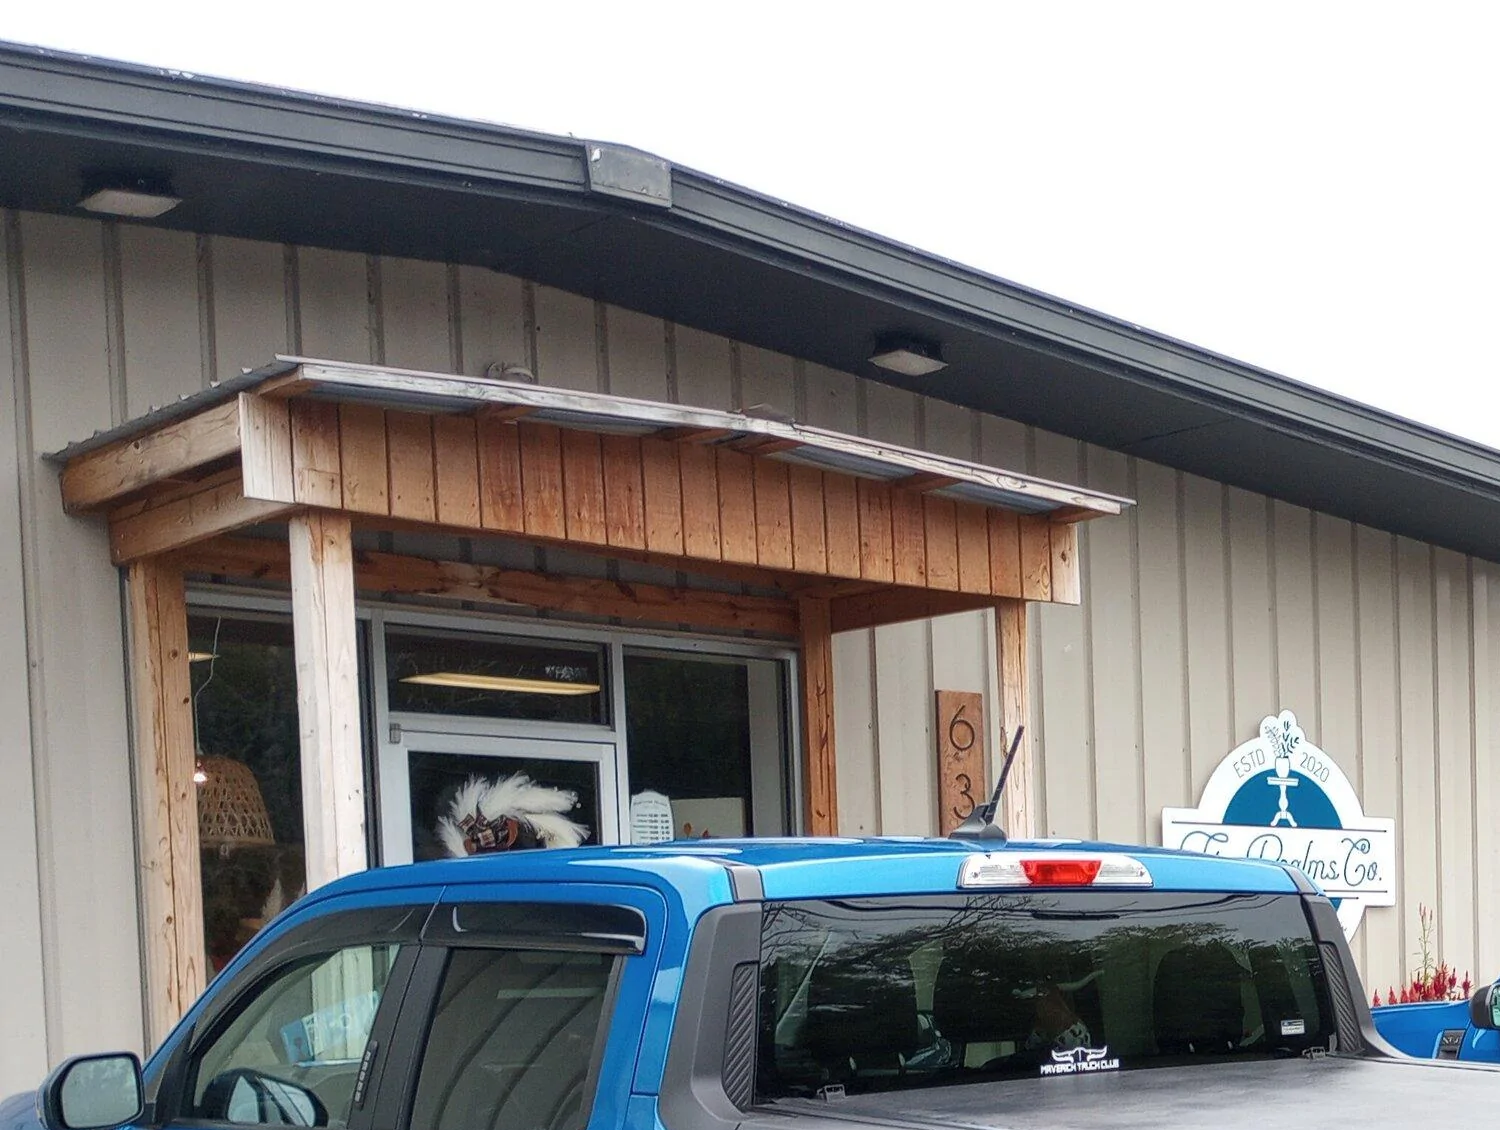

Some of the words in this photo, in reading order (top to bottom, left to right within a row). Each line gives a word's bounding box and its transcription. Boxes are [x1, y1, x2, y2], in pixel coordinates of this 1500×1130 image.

[1232, 748, 1266, 779] ESTD
[1299, 751, 1331, 784] 2020
[1341, 837, 1383, 887] Co.
[1040, 1062, 1077, 1075] MAVERICK
[1100, 1058, 1120, 1070] CLUB
